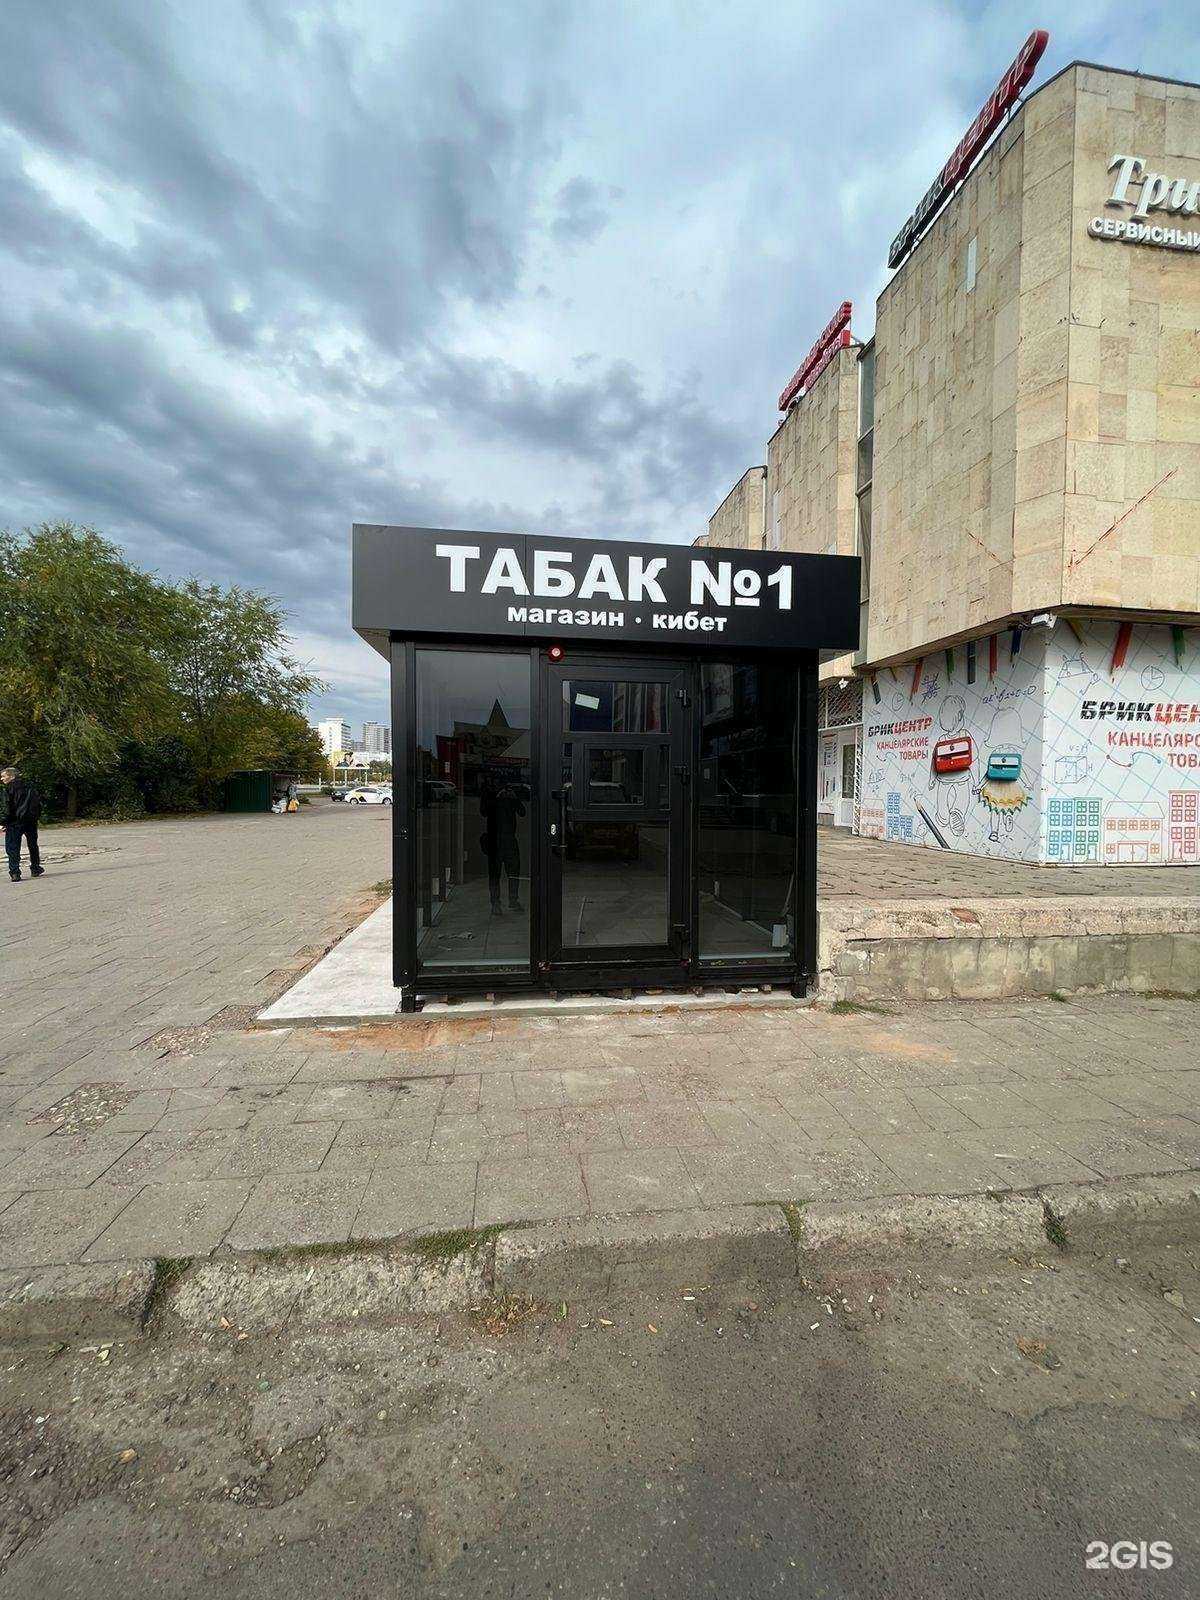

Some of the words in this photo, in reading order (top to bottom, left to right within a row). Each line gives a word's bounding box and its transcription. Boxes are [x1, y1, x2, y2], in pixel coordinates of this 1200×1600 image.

[435, 544, 668, 604] ТАБАК
[507, 605, 625, 628] магазин
[651, 609, 728, 633] кибет
[868, 716, 934, 738] БРИКЦЕНТР
[876, 736, 930, 751] КАНЦЕЛЯРСКИЕ
[899, 749, 930, 761] ТОВАРЫ
[1168, 752, 1200, 769] ТОВ
